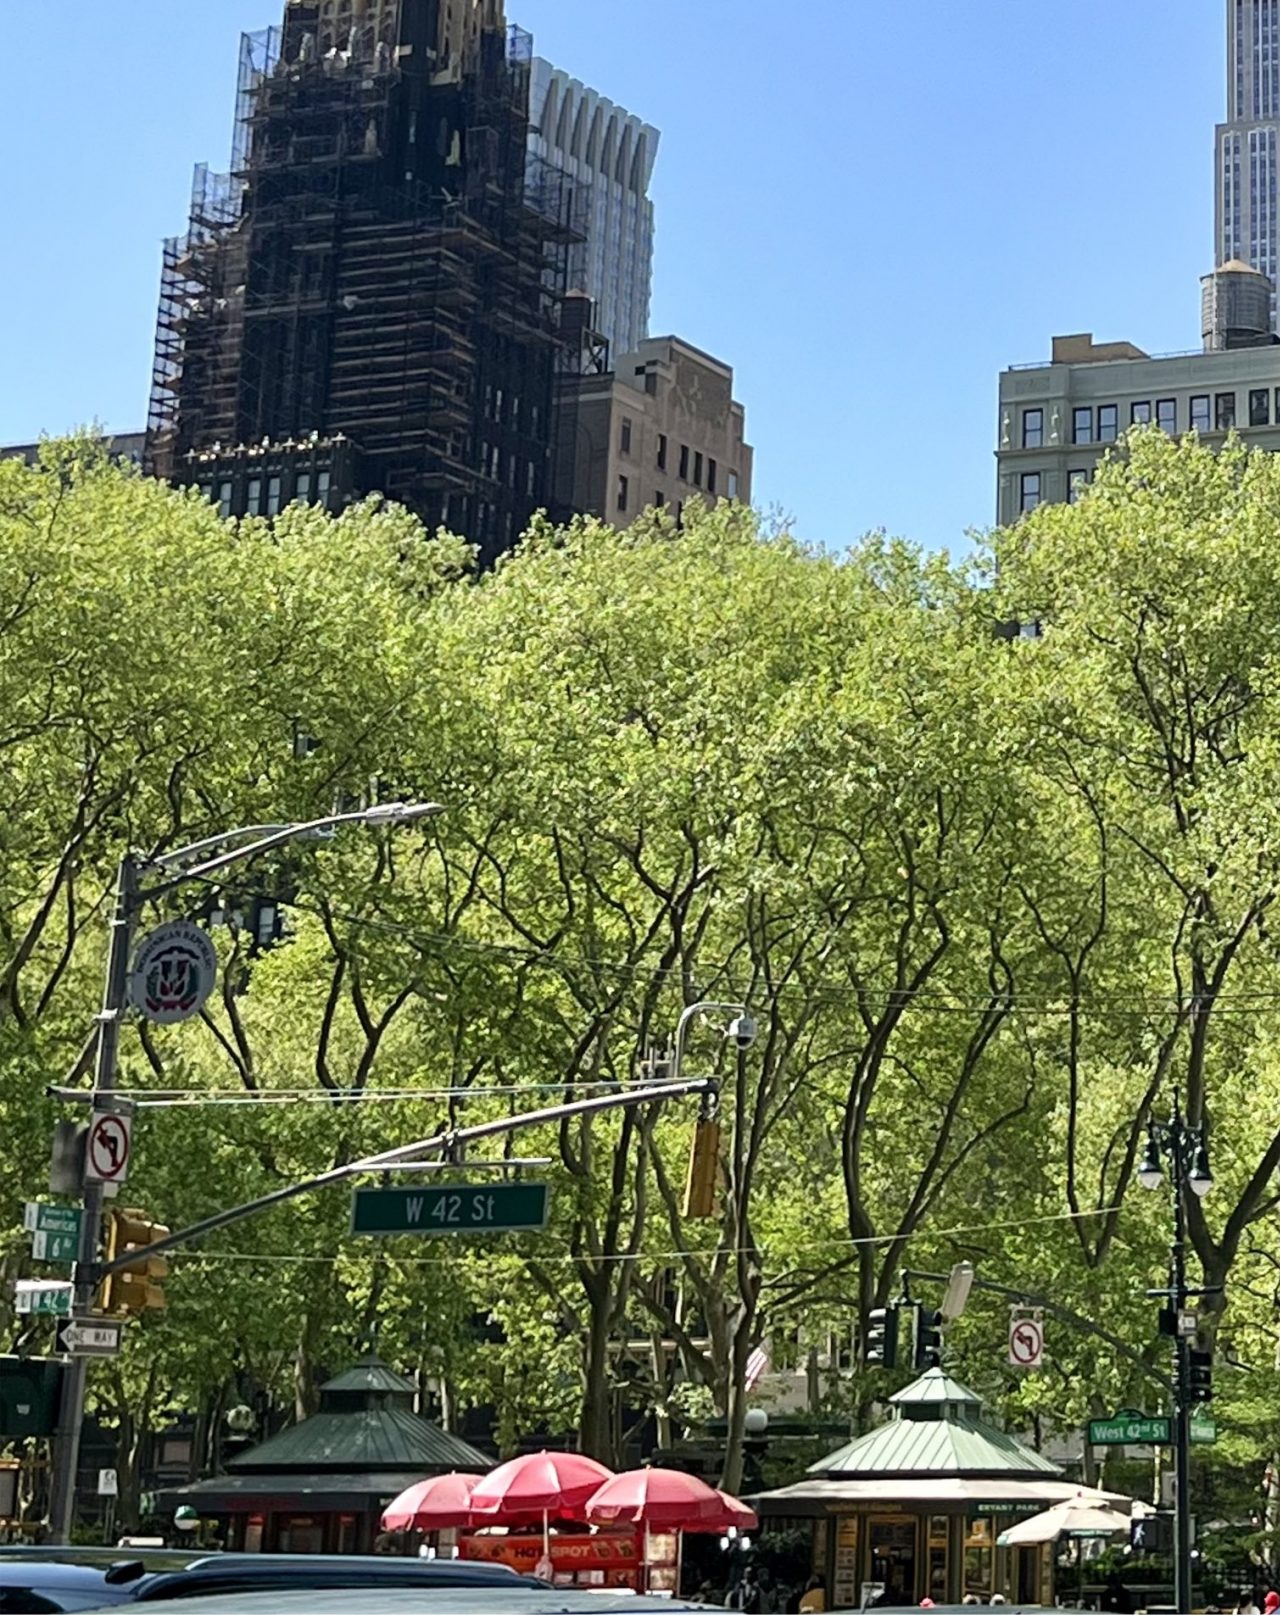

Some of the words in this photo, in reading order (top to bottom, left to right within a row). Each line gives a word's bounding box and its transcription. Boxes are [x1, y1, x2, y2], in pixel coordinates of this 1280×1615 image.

[406, 1197, 424, 1223] W
[431, 1195, 461, 1222] 42
[471, 1195, 495, 1221] St
[66, 1329, 86, 1344] ONE
[94, 1331, 114, 1344] WAY
[1094, 1426, 1124, 1439] West
[1152, 1424, 1166, 1438] St
[978, 1504, 1013, 1512] BRYANT
[551, 1545, 590, 1557] SPOT
